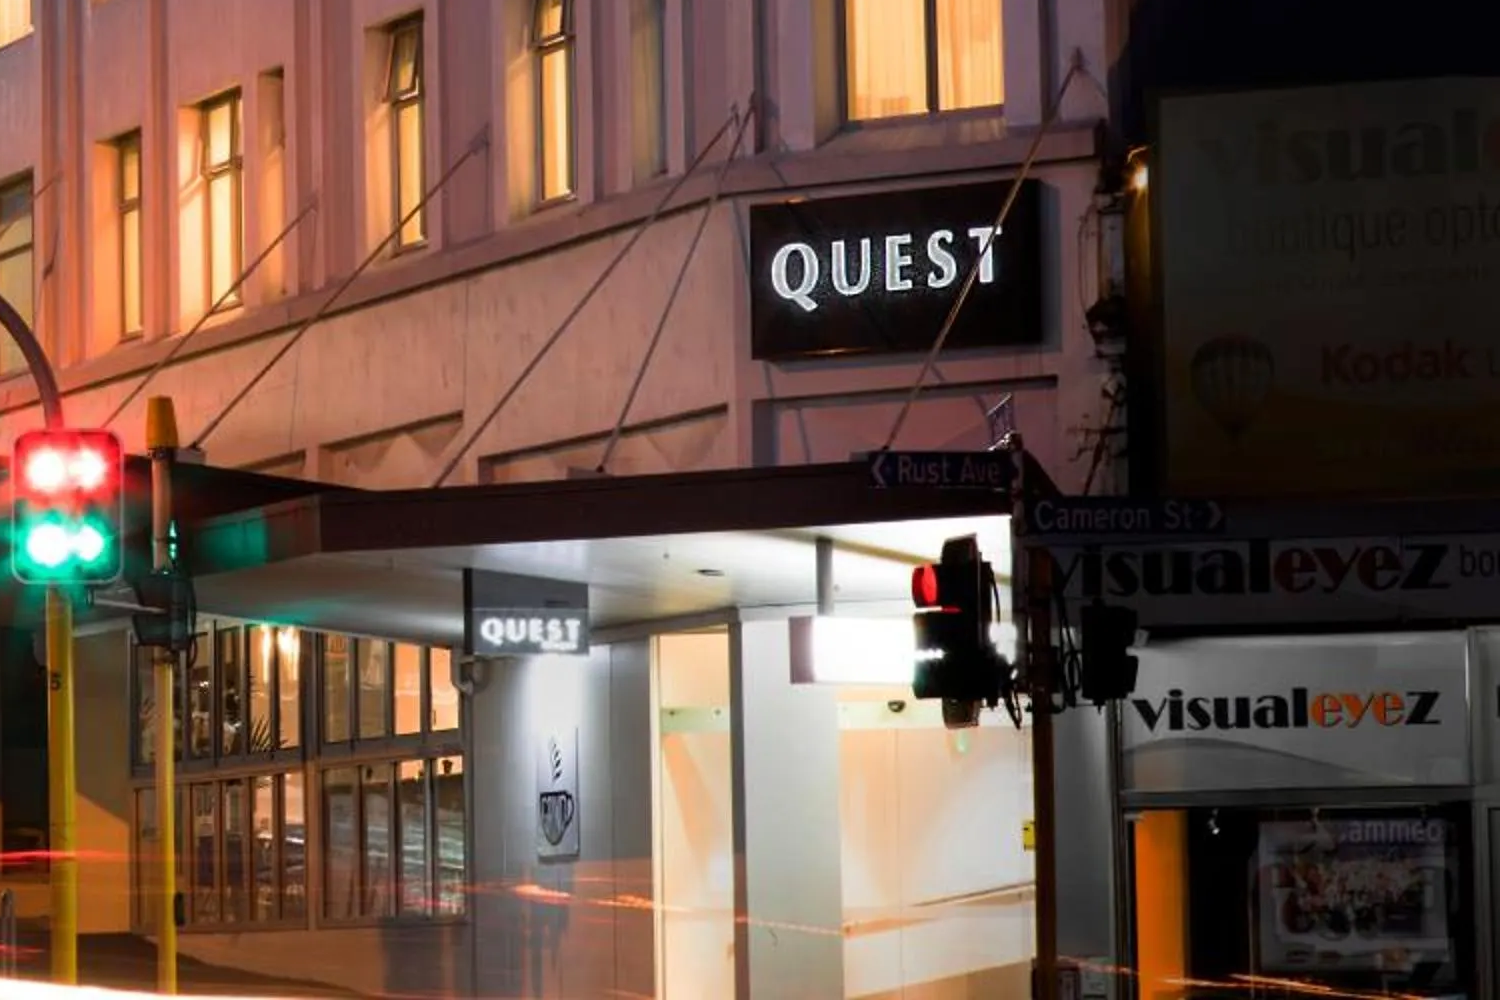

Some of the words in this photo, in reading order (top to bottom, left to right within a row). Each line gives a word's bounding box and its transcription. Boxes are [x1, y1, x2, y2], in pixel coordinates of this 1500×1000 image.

[771, 225, 1002, 312] QUEST
[1321, 337, 1474, 384] Kodak
[897, 455, 951, 483] Rust
[960, 455, 1000, 483] Ave
[1034, 500, 1150, 530] Cameron
[1164, 500, 1192, 530] St
[481, 617, 580, 646] QUEST
[1134, 687, 1441, 731] visualeyez
